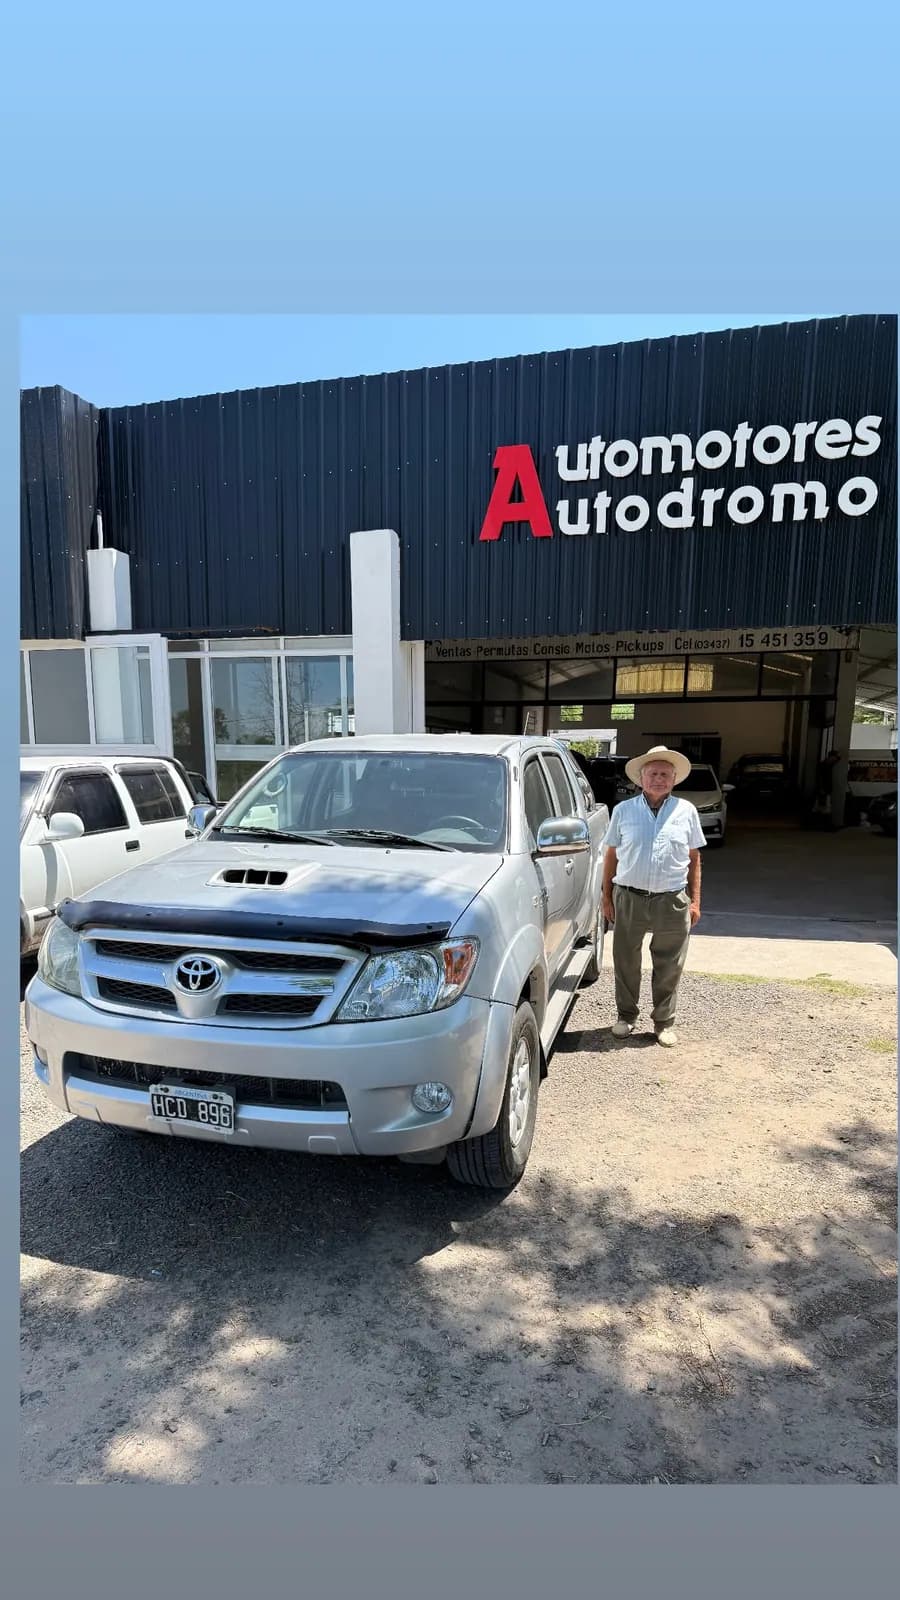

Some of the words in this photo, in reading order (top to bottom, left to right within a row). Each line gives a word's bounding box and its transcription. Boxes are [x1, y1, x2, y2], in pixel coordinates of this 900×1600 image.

[435, 645, 472, 658] Ventas
[476, 644, 529, 657] Permutas
[738, 633, 755, 647] 15
[761, 633, 787, 648] 451
[793, 631, 829, 647] 359
[153, 1095, 187, 1118] HCD
[198, 1101, 230, 1127] 896
